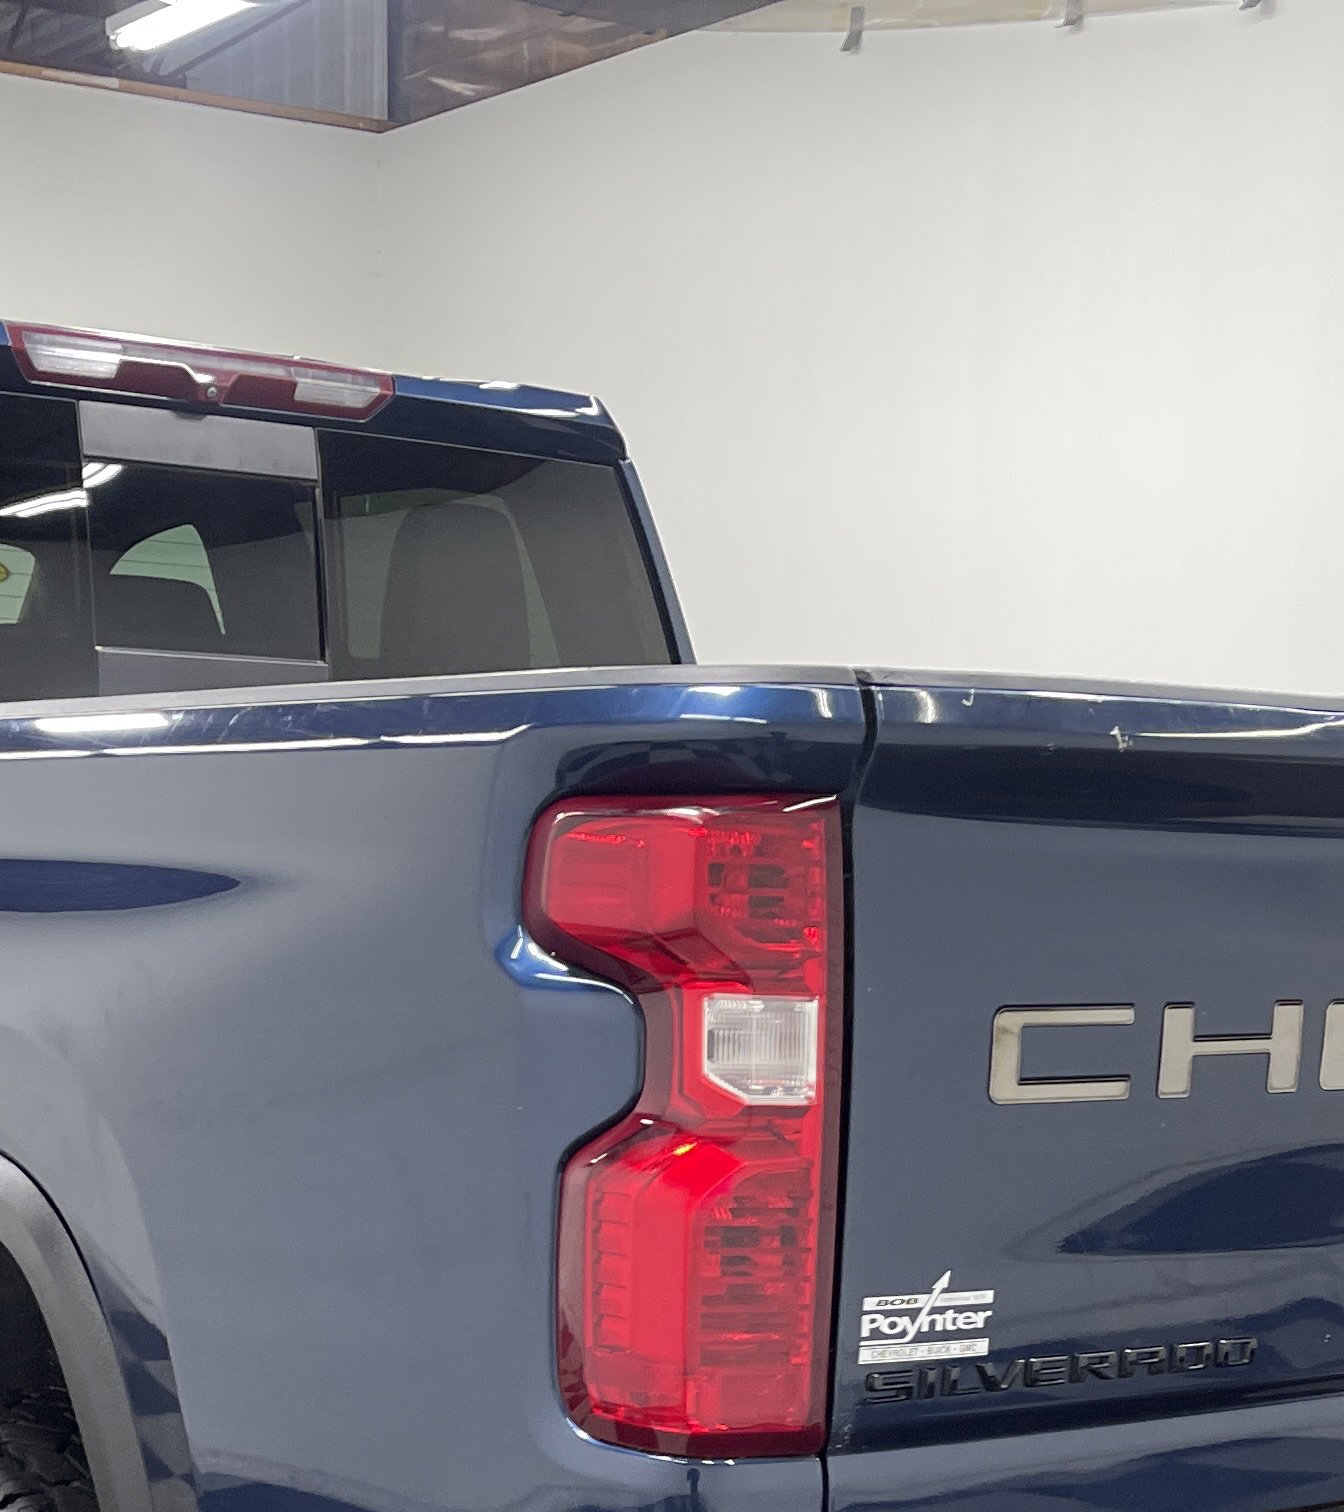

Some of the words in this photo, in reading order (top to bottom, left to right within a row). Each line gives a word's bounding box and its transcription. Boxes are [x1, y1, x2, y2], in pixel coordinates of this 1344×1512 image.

[876, 1296, 919, 1307] BOB
[860, 1308, 993, 1341] Poynter
[864, 1336, 1258, 1404] SILVERADO
